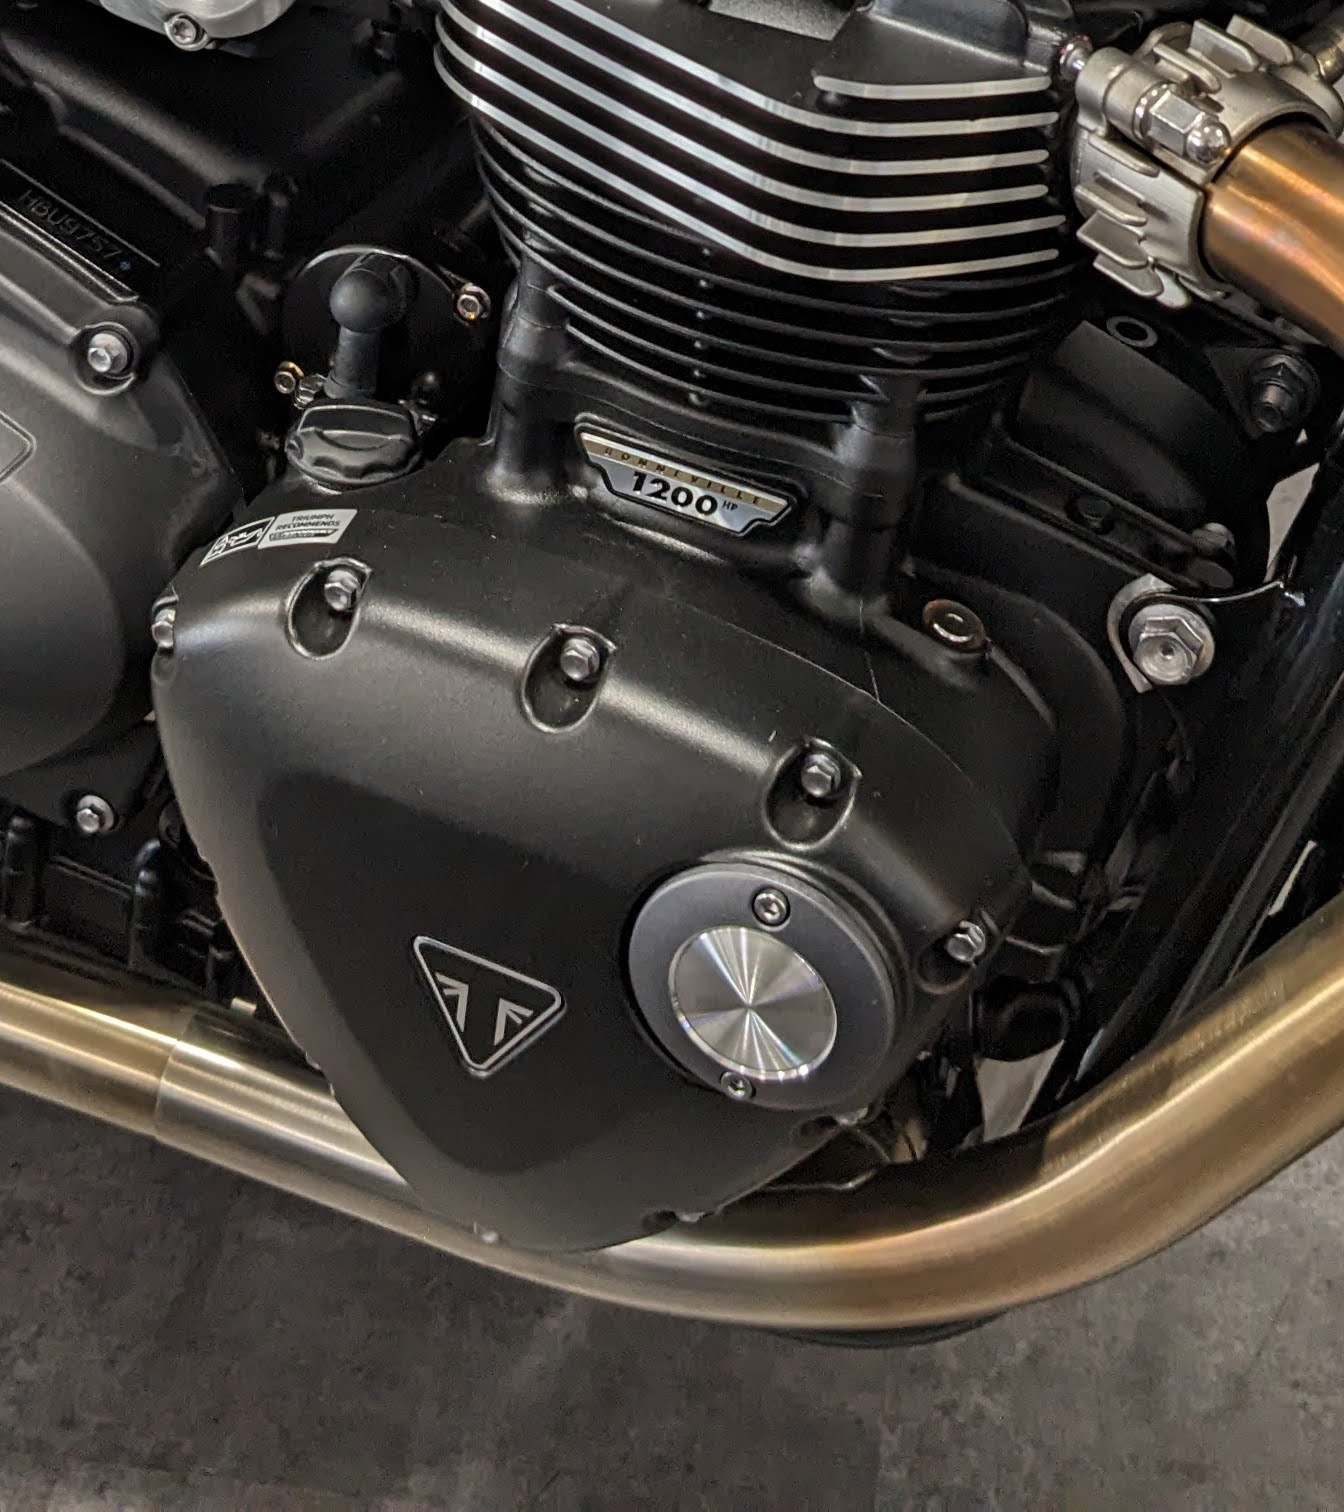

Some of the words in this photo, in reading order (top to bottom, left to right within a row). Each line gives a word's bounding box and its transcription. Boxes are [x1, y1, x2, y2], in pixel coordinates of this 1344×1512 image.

[604, 447, 761, 506] BONNEVILLE
[632, 471, 718, 516] 1200
[722, 499, 739, 512] HP
[291, 513, 335, 523] TRIUMPH
